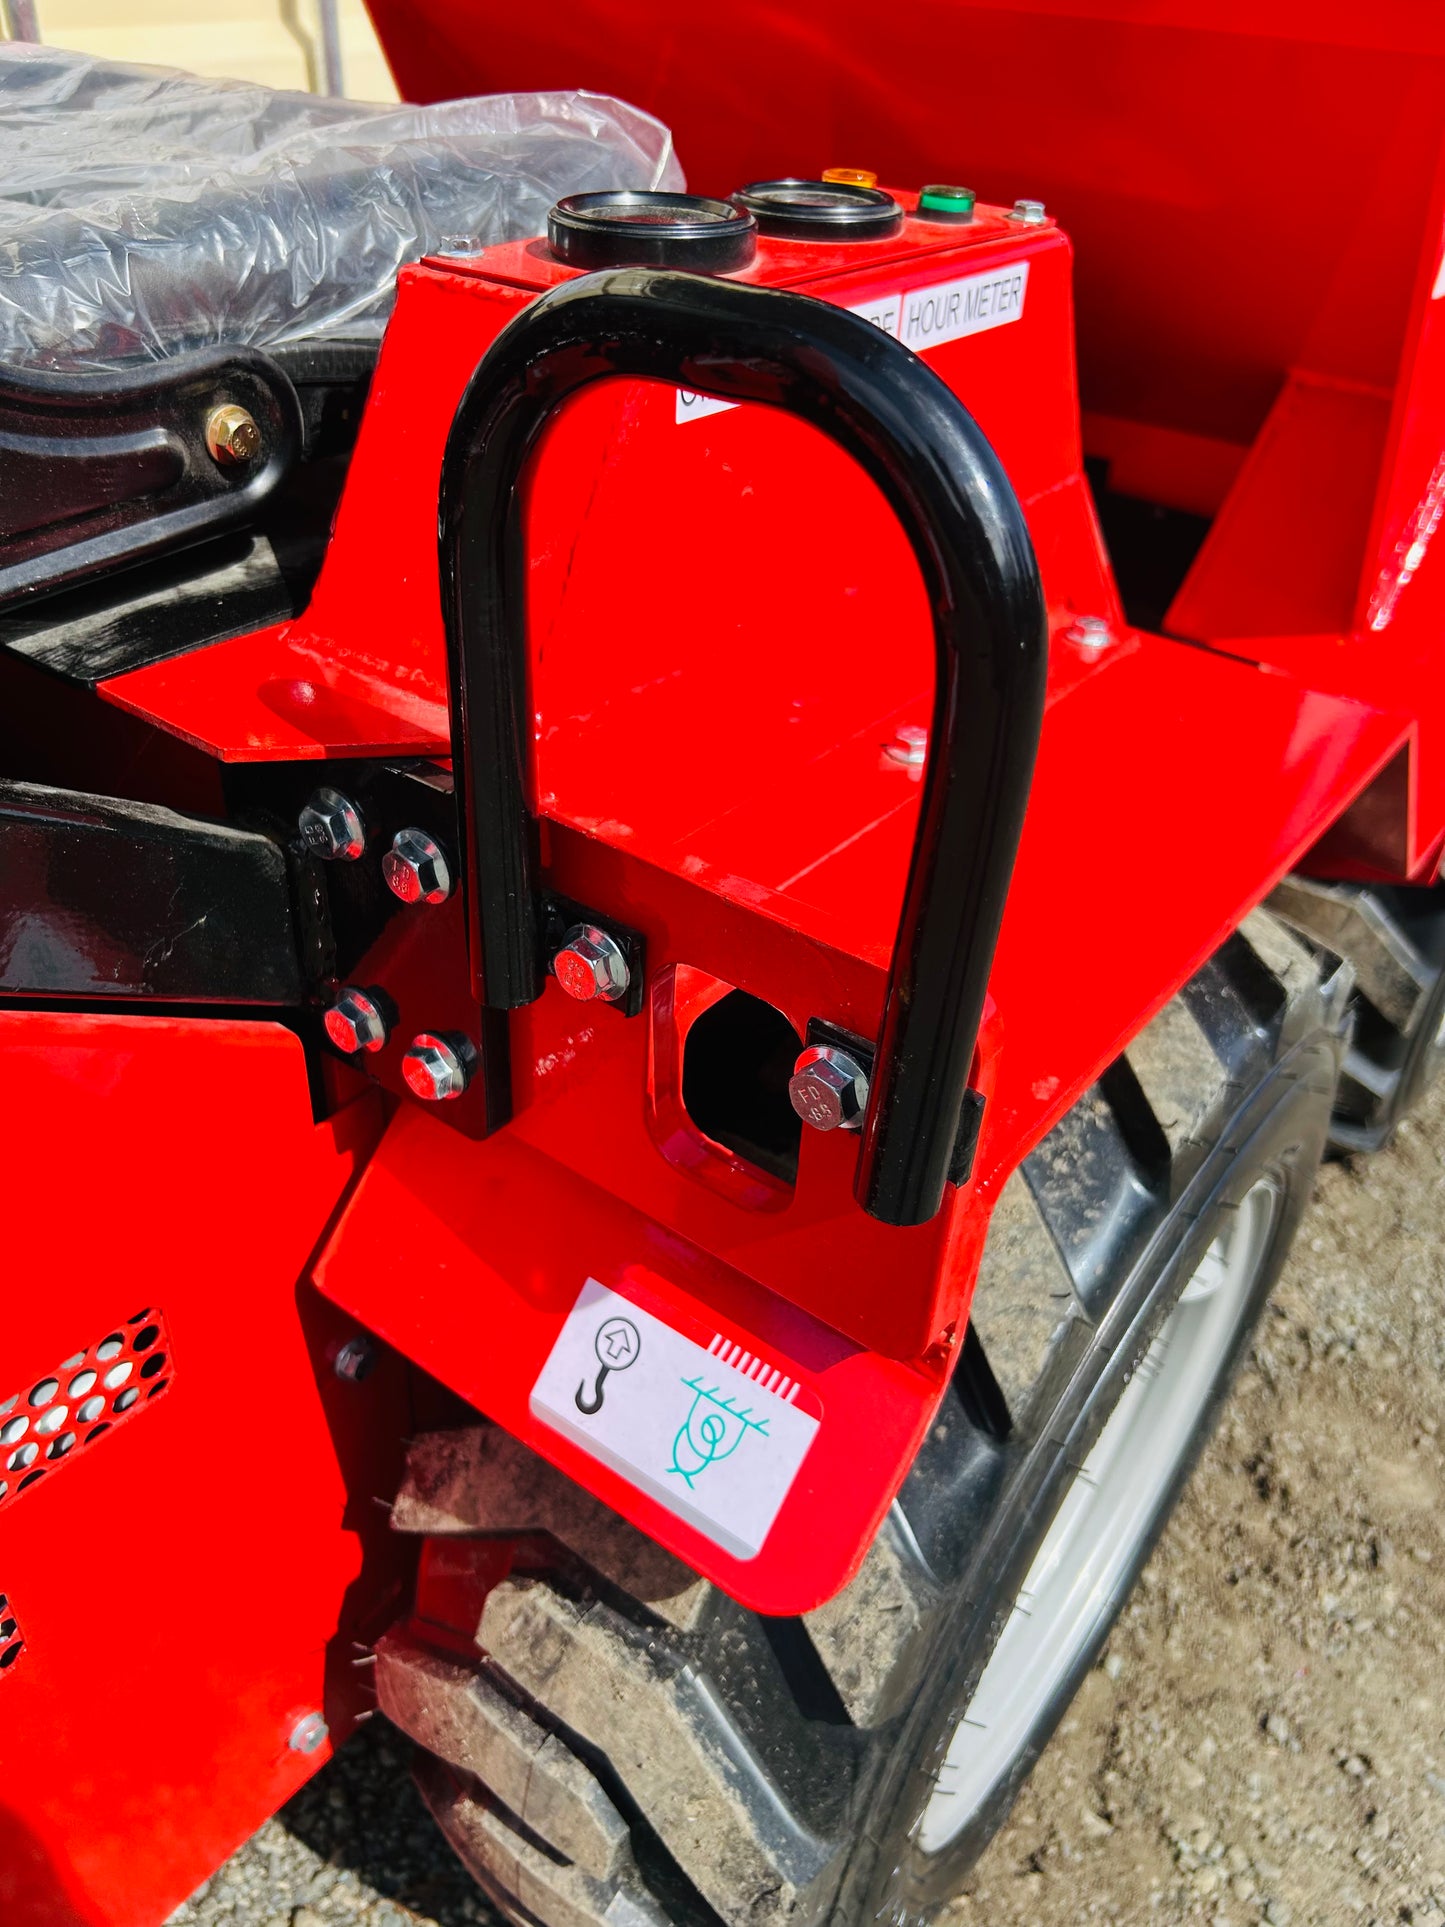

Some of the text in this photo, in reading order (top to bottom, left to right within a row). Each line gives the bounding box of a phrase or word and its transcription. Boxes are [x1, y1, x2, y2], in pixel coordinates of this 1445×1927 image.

[906, 293, 960, 340] HOUR
[963, 275, 1022, 321] METER
[797, 1085, 821, 1104] FD
